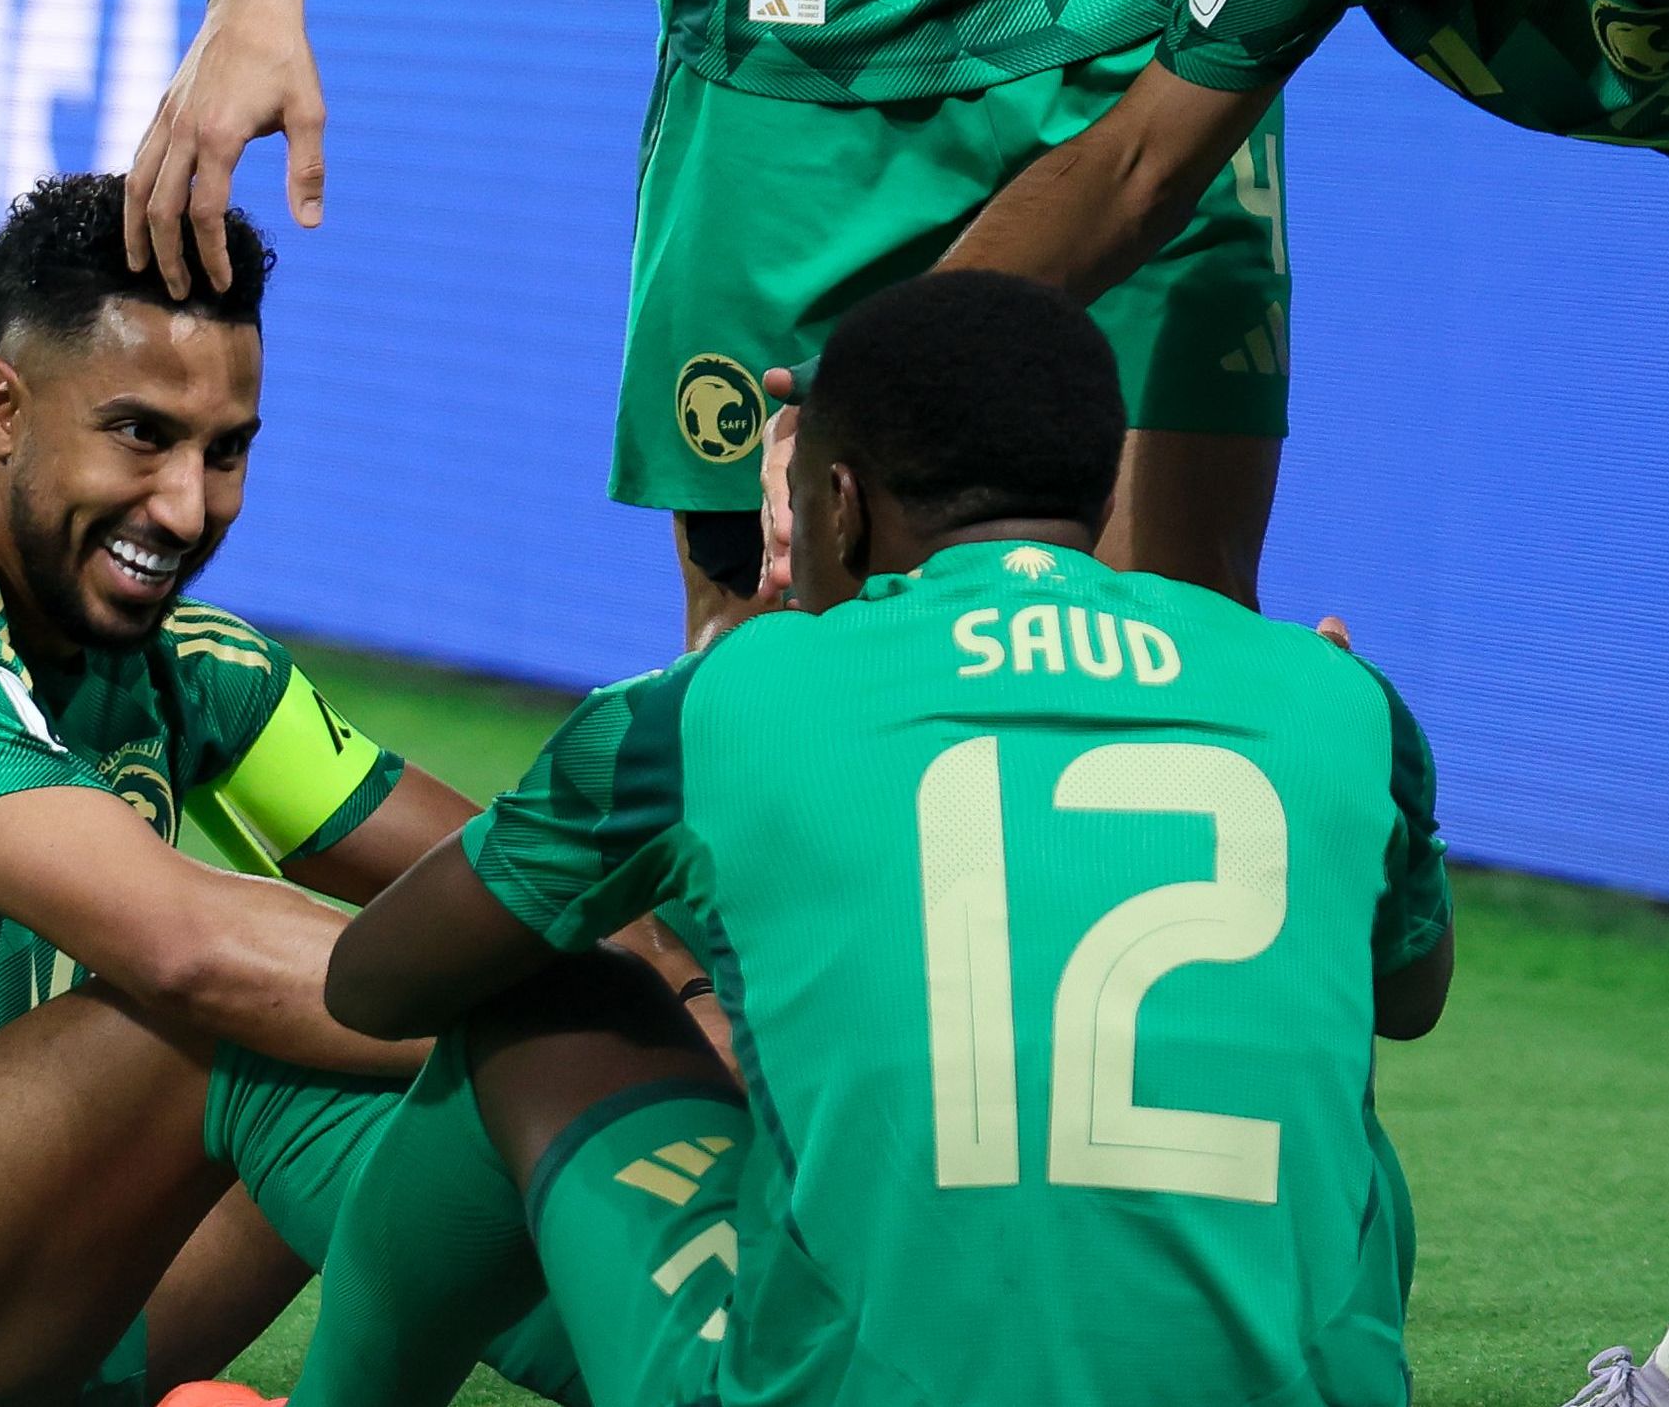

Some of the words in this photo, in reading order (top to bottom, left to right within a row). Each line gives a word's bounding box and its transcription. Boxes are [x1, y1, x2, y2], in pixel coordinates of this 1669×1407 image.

[1231, 133, 1286, 275] 4
[720, 420, 748, 430] SAFF
[952, 603, 1182, 685] SAUD
[916, 734, 1288, 1205] 12
